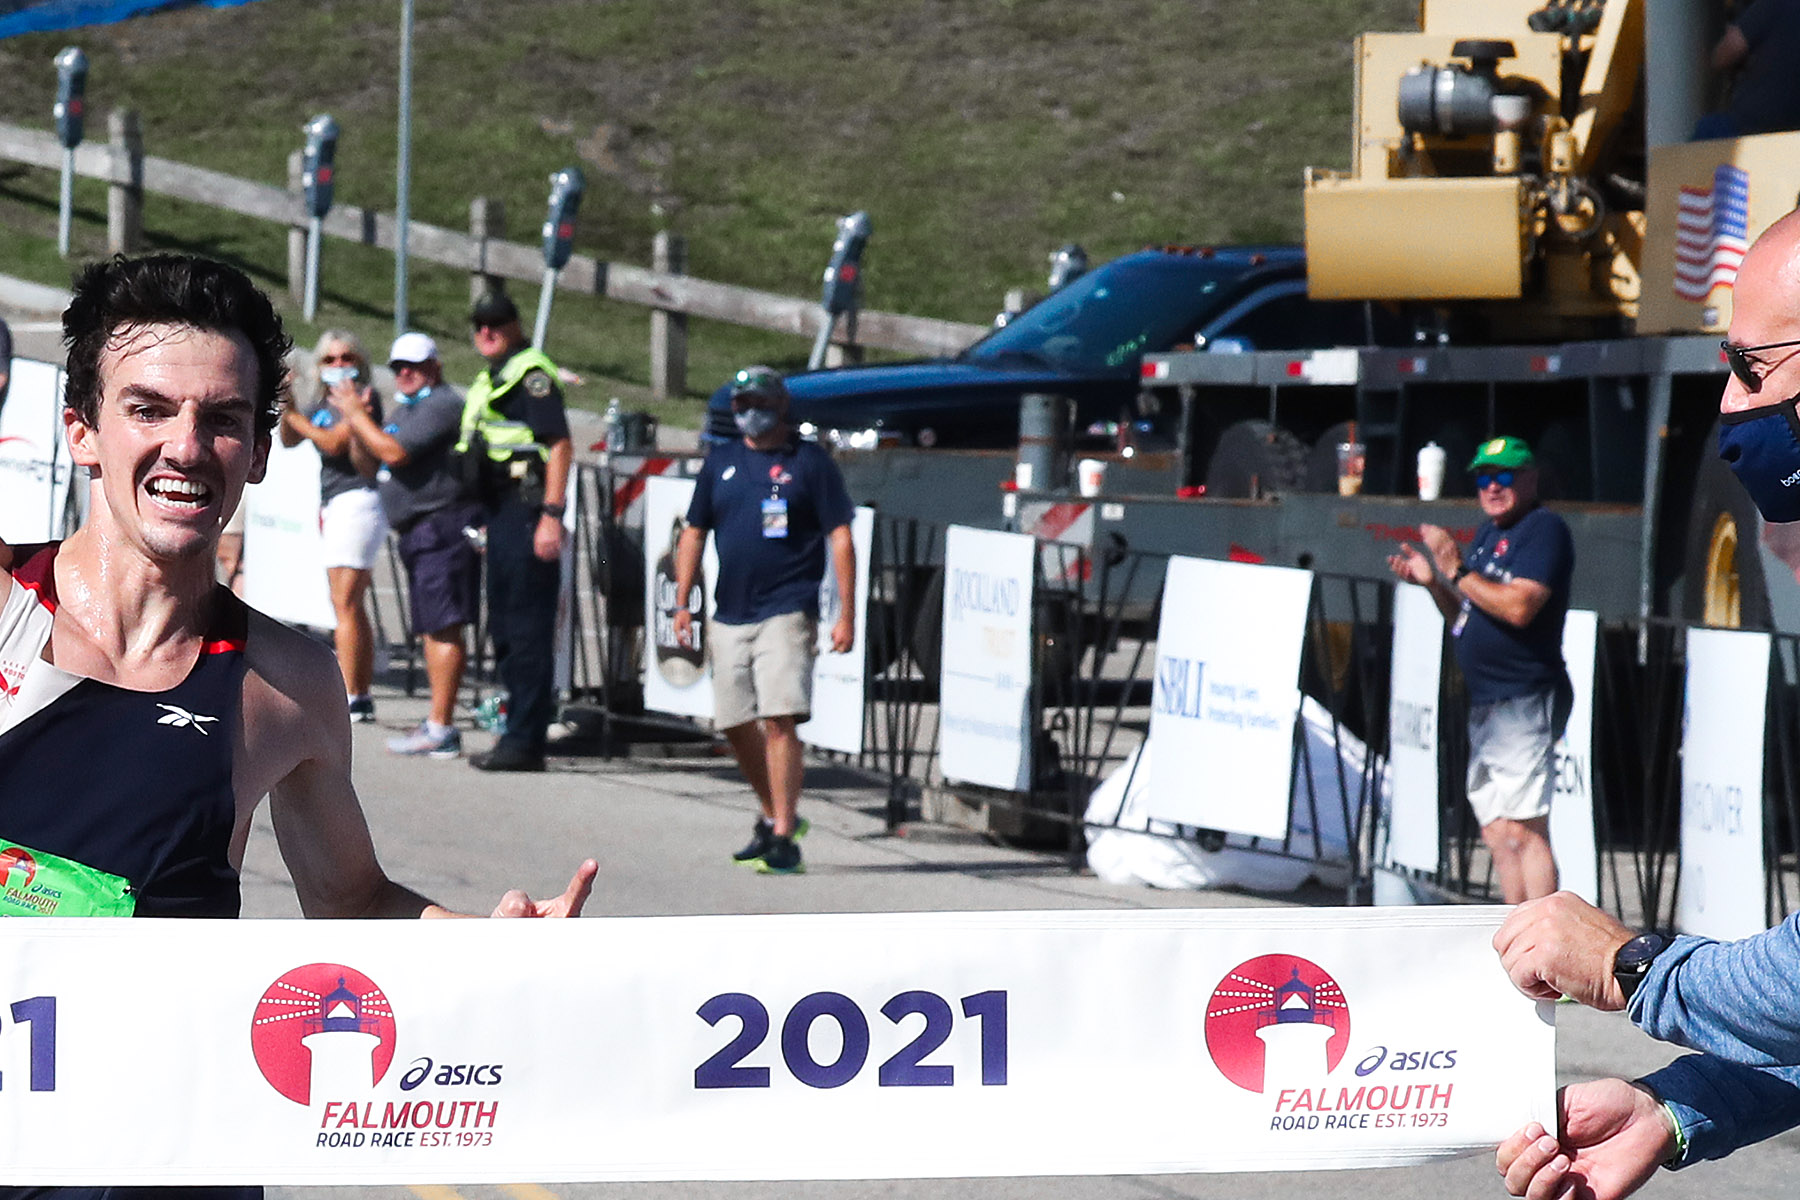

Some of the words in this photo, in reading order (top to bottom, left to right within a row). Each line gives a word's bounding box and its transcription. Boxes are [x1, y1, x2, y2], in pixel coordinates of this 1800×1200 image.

[1157, 655, 1206, 719] SBLI
[6, 887, 59, 910] FALMOUTH
[695, 990, 1008, 1089] 2021
[1390, 1050, 1458, 1070] asics
[435, 1064, 503, 1085] asics
[1275, 1083, 1454, 1113] FALMOUTH
[321, 1101, 499, 1129] FALMOUTH
[1270, 1115, 1319, 1130] ROAD
[1325, 1114, 1370, 1129] RACE
[1375, 1113, 1407, 1128] EST.
[1410, 1112, 1449, 1127] 1973
[316, 1132, 365, 1148] ROAD
[371, 1132, 415, 1148] RACE
[419, 1132, 451, 1147] EST.
[455, 1132, 493, 1147] 1973
